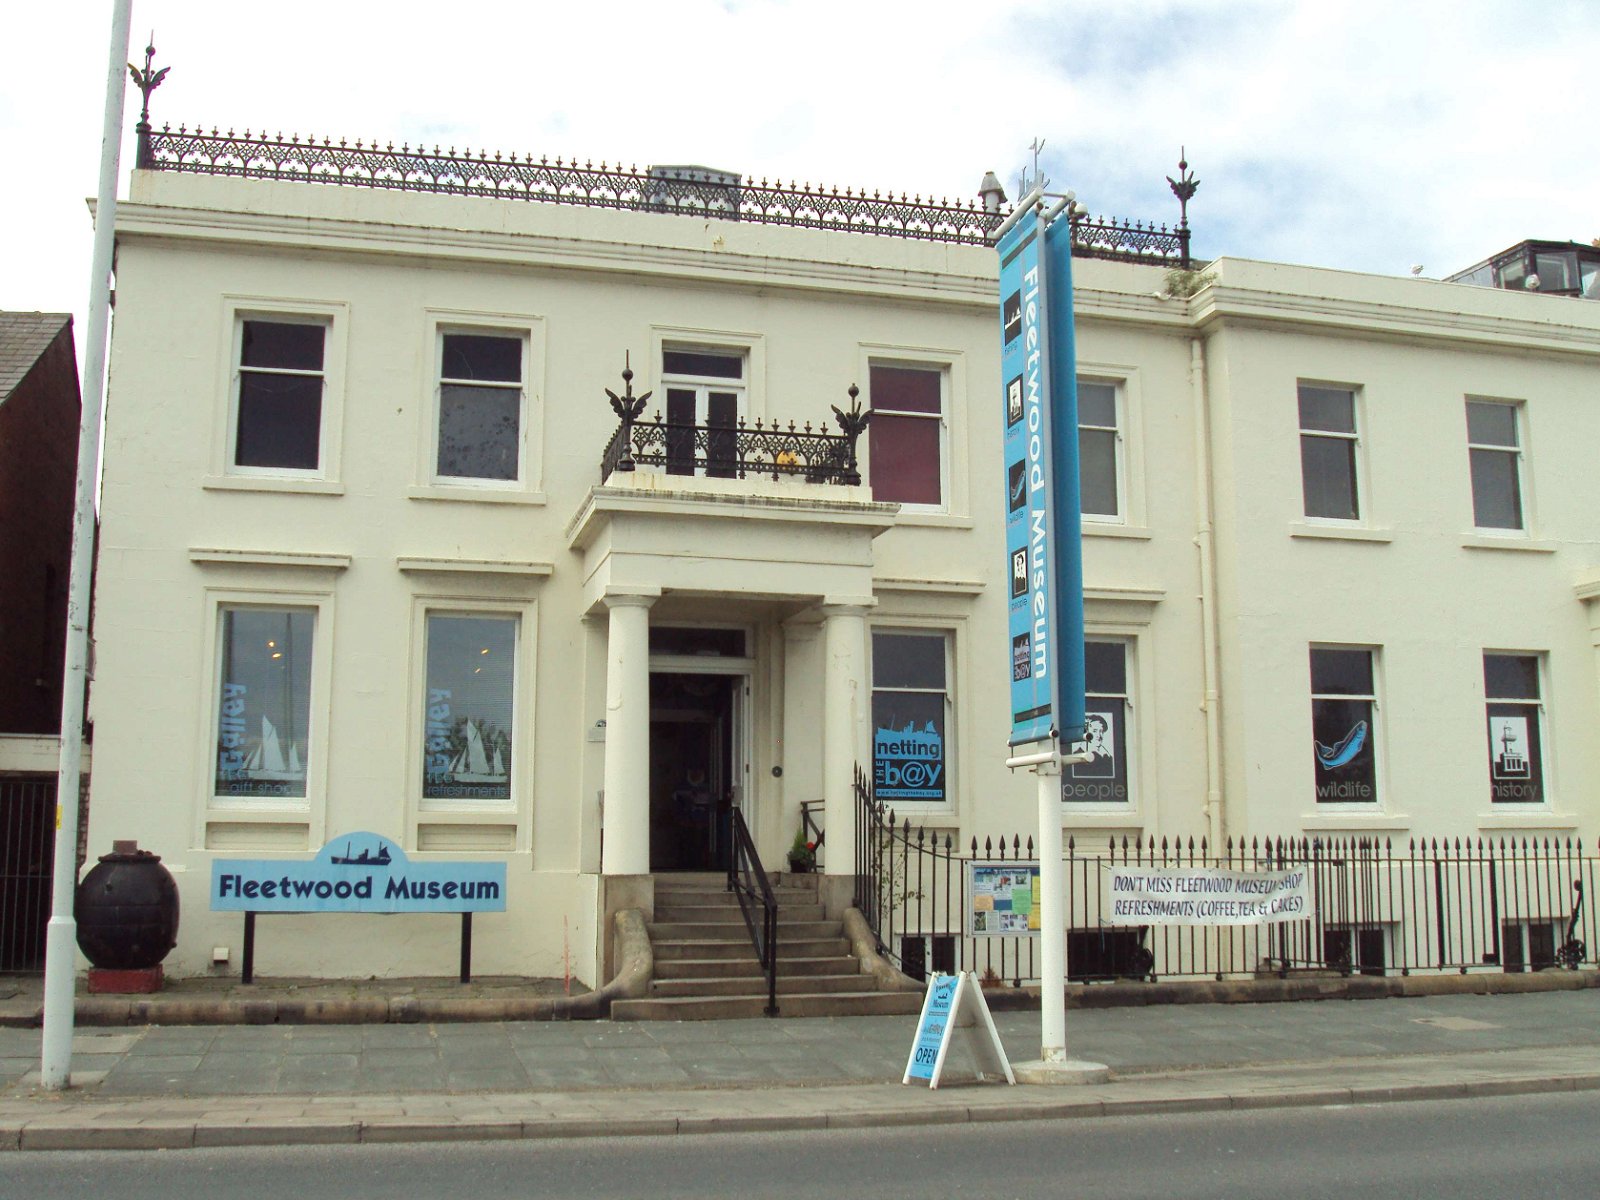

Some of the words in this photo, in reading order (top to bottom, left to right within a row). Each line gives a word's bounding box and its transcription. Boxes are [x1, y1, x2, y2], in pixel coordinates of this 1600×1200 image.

[1024, 266, 1045, 493] Fleetwood
[1031, 509, 1047, 679] Museum
[220, 683, 247, 770] Galley
[427, 688, 452, 772] Galley
[877, 739, 940, 758] netting
[876, 760, 885, 784] THE
[885, 761, 942, 787] b@y
[427, 785, 506, 797] refreshments
[1062, 781, 1126, 800] people
[1316, 781, 1371, 799] wildlife
[1491, 782, 1538, 800] history
[219, 874, 373, 899] Fleetwood
[384, 876, 499, 900] Museum
[1113, 876, 1144, 892] DON'T
[1147, 876, 1172, 893] MISS
[1175, 877, 1232, 893] FLEETWOOD
[1279, 872, 1304, 890] SHOP
[1115, 900, 1195, 916] REFRESHMENTS
[1259, 901, 1268, 915] &
[1270, 895, 1304, 914] CAKES)
[915, 1047, 939, 1065] OPEN
